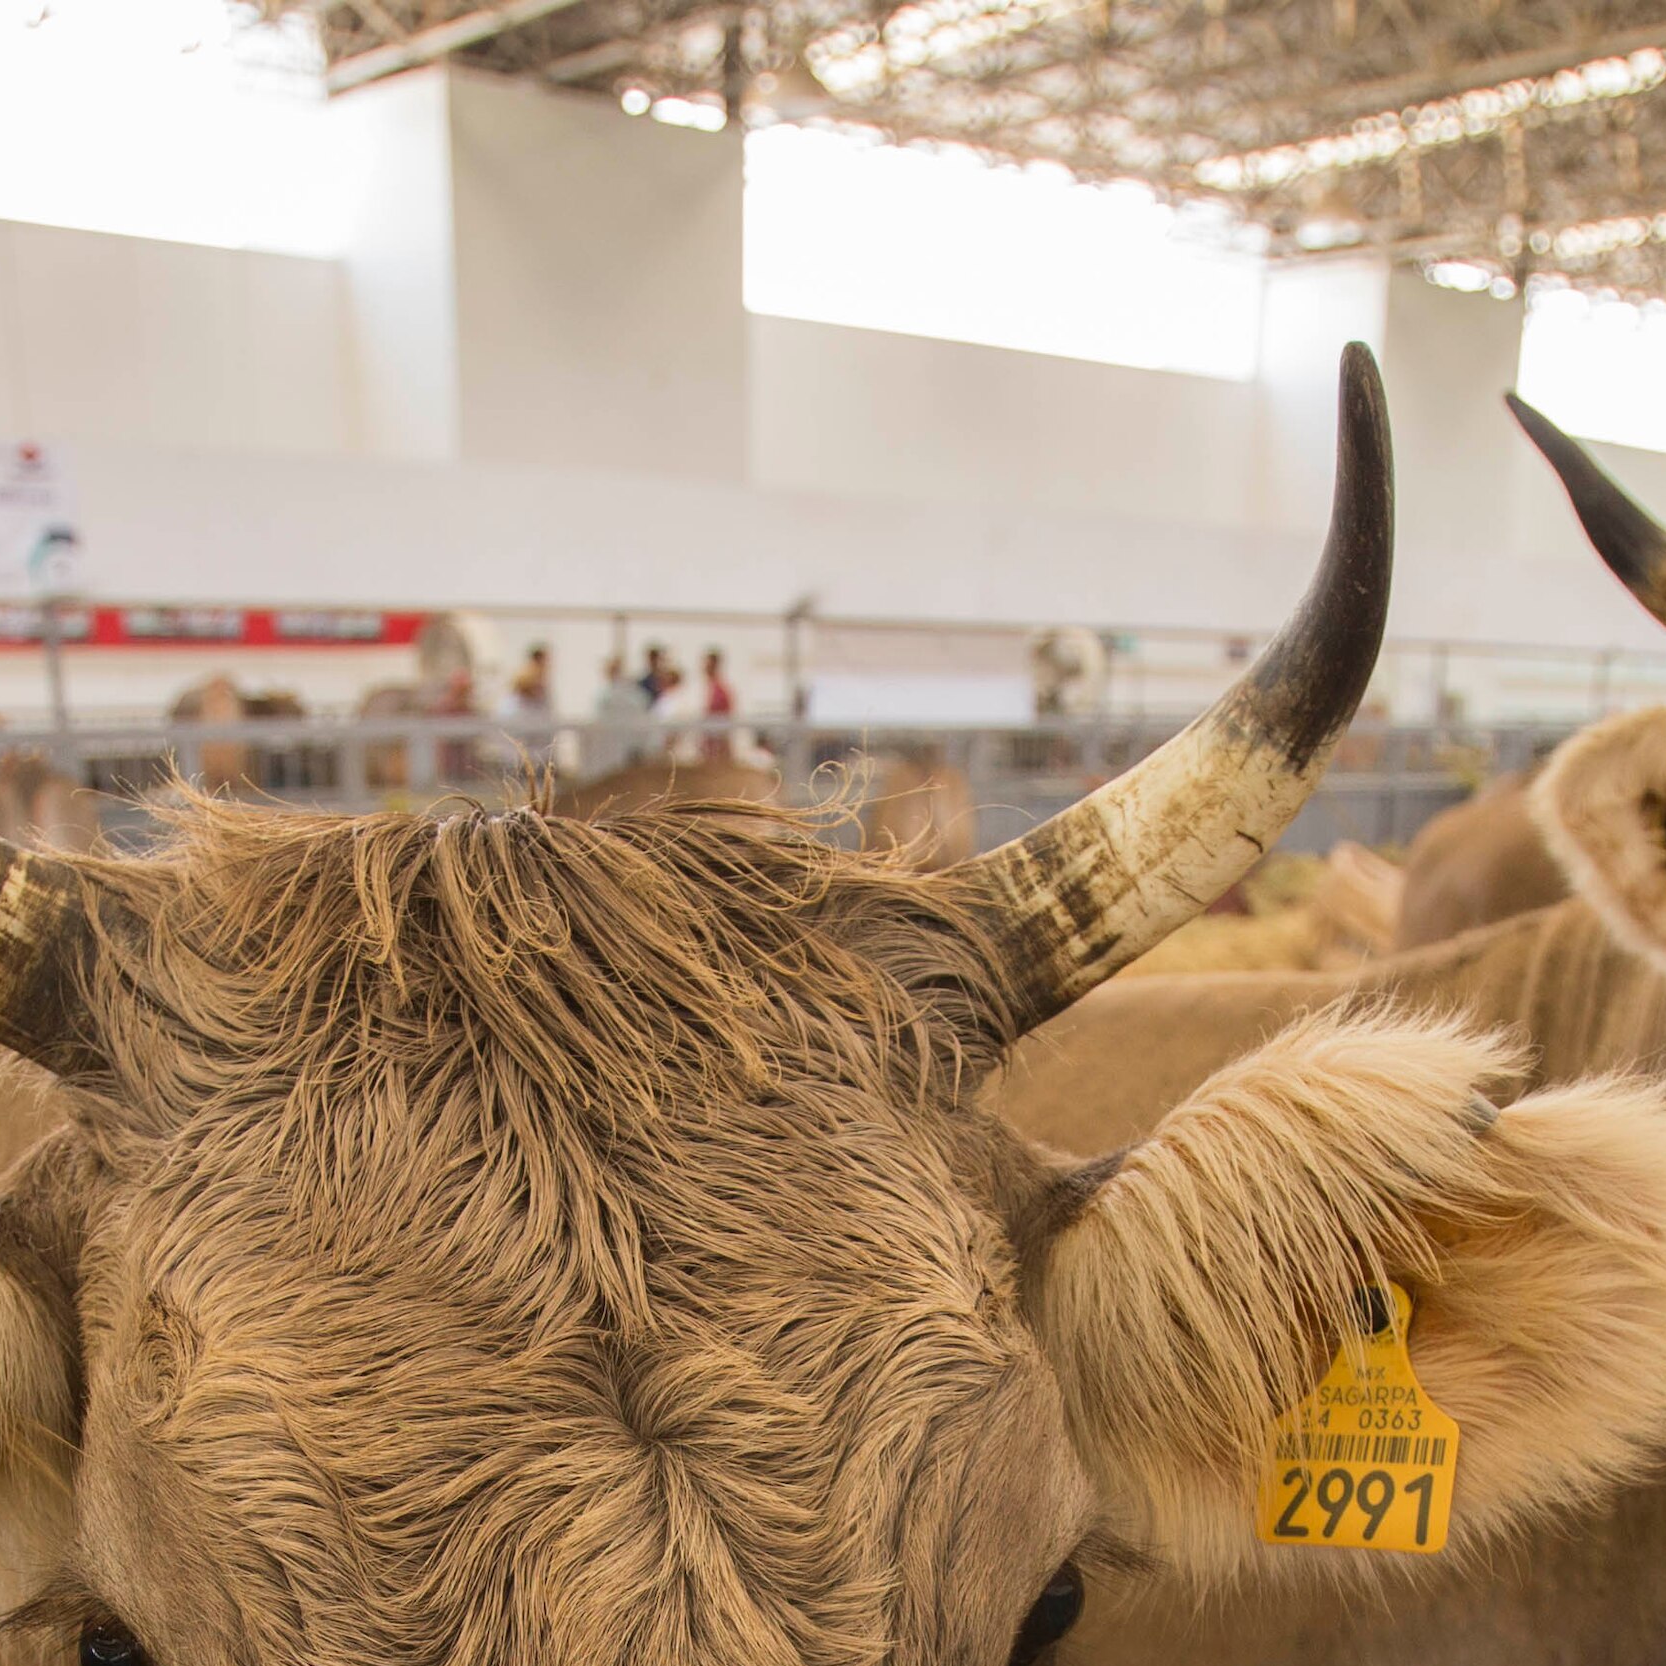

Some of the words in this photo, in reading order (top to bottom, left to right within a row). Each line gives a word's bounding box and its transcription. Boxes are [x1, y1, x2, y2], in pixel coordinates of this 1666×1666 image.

[1319, 1385, 1419, 1408] SAGARPA
[1358, 1408, 1424, 1430] 0363
[1273, 1466, 1435, 1546] 2991
